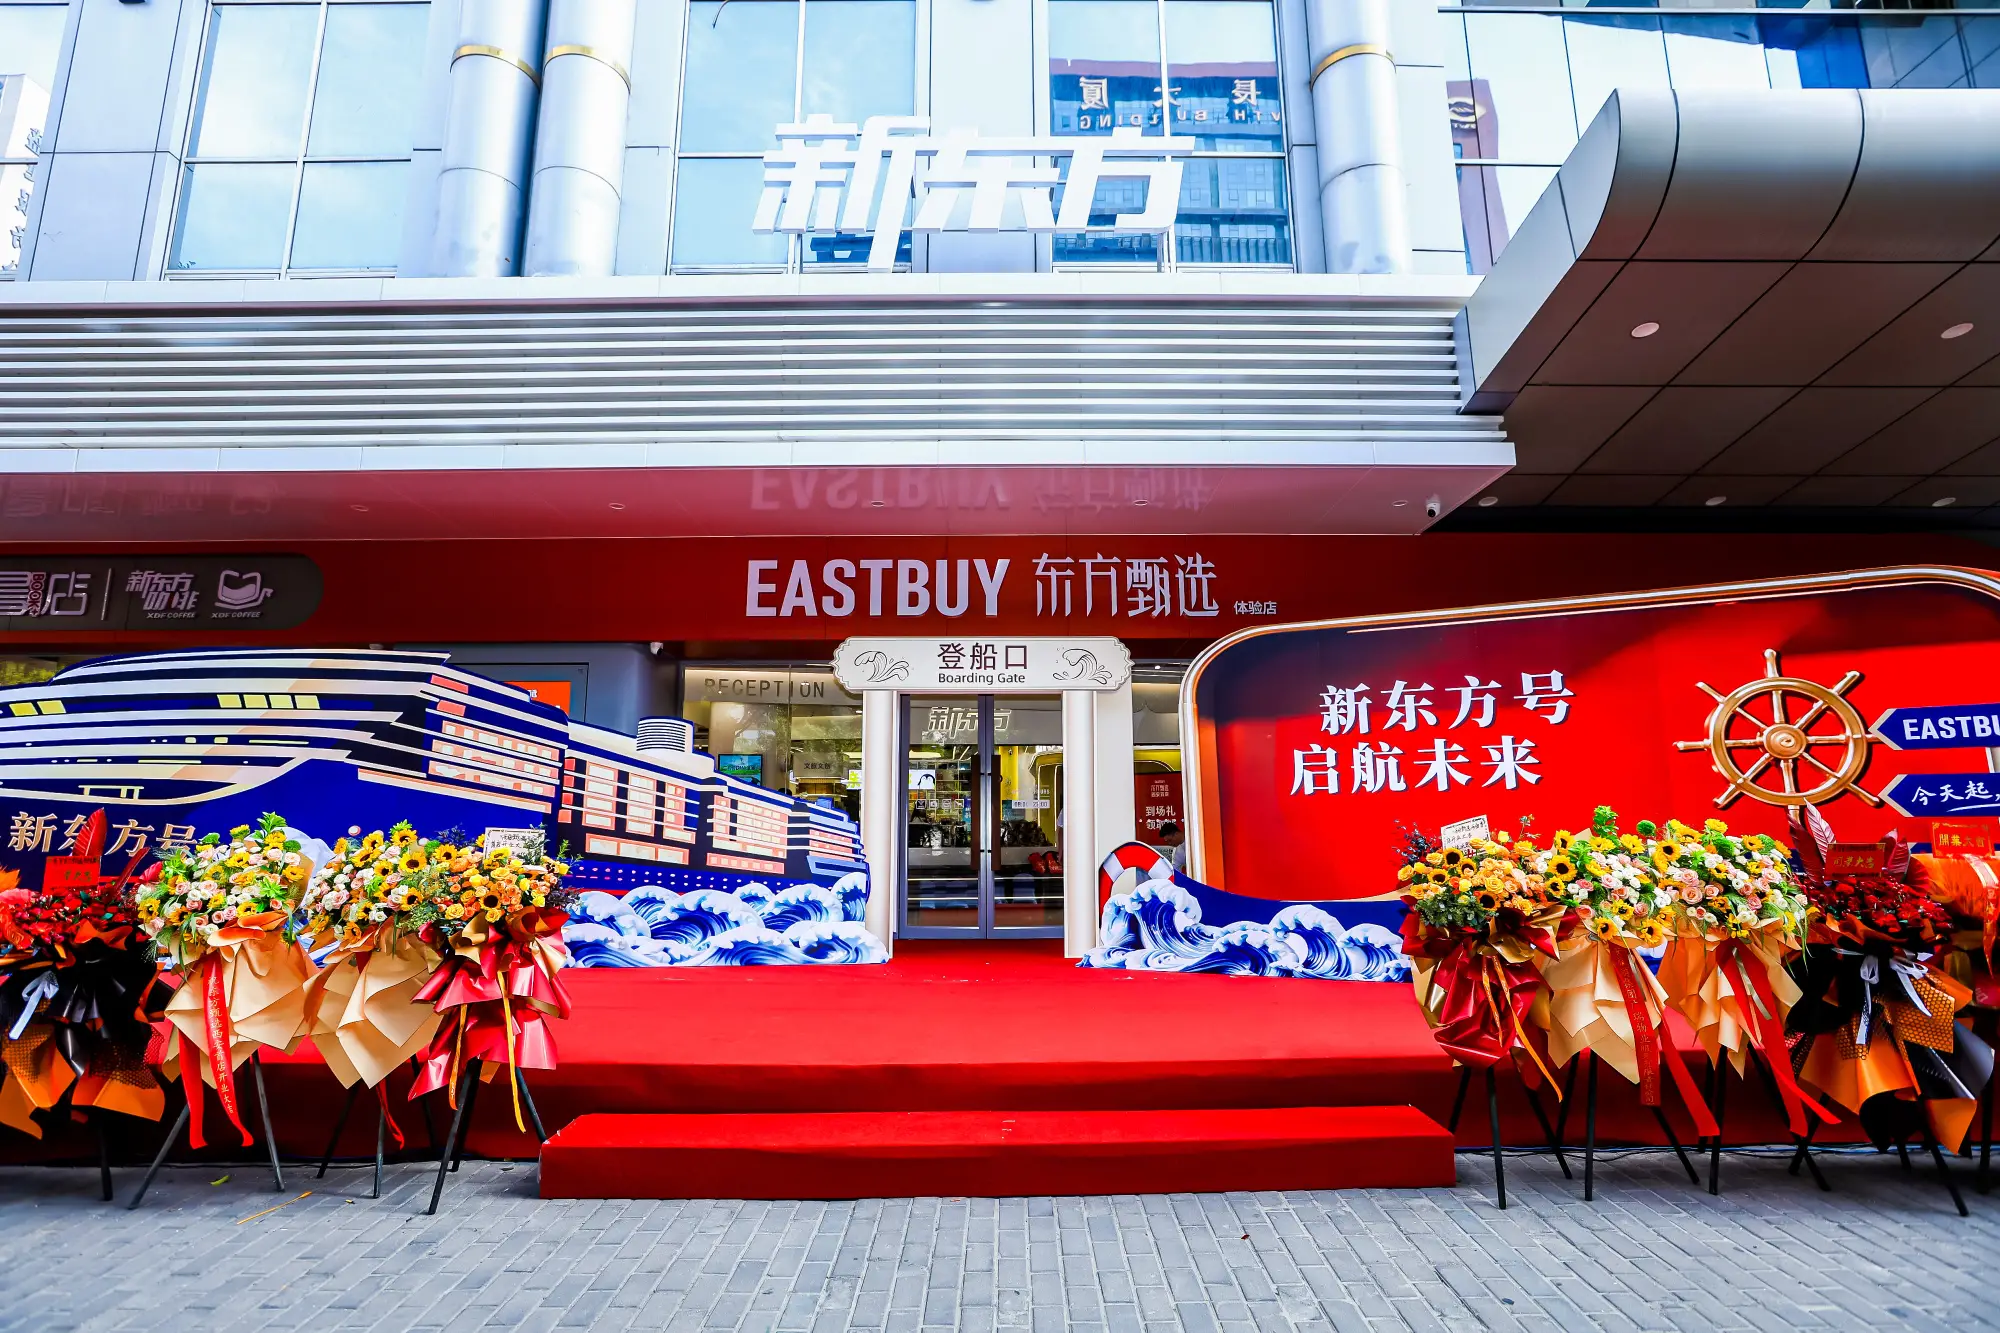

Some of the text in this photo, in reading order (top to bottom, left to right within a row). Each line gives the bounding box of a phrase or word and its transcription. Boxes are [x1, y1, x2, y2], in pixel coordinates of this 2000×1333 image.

[752, 113, 1196, 272] 新东方
[126, 570, 195, 598] 新东方
[745, 552, 1277, 617] EASTBUY 东方甄选 体验店
[143, 590, 199, 610] 咖啡
[937, 642, 1027, 670] 登船口
[704, 678, 825, 698] RECEPTION
[938, 673, 1026, 686] Boarding Gate
[1319, 669, 1576, 735] 新东方号
[1290, 735, 1542, 796] 启航未来
